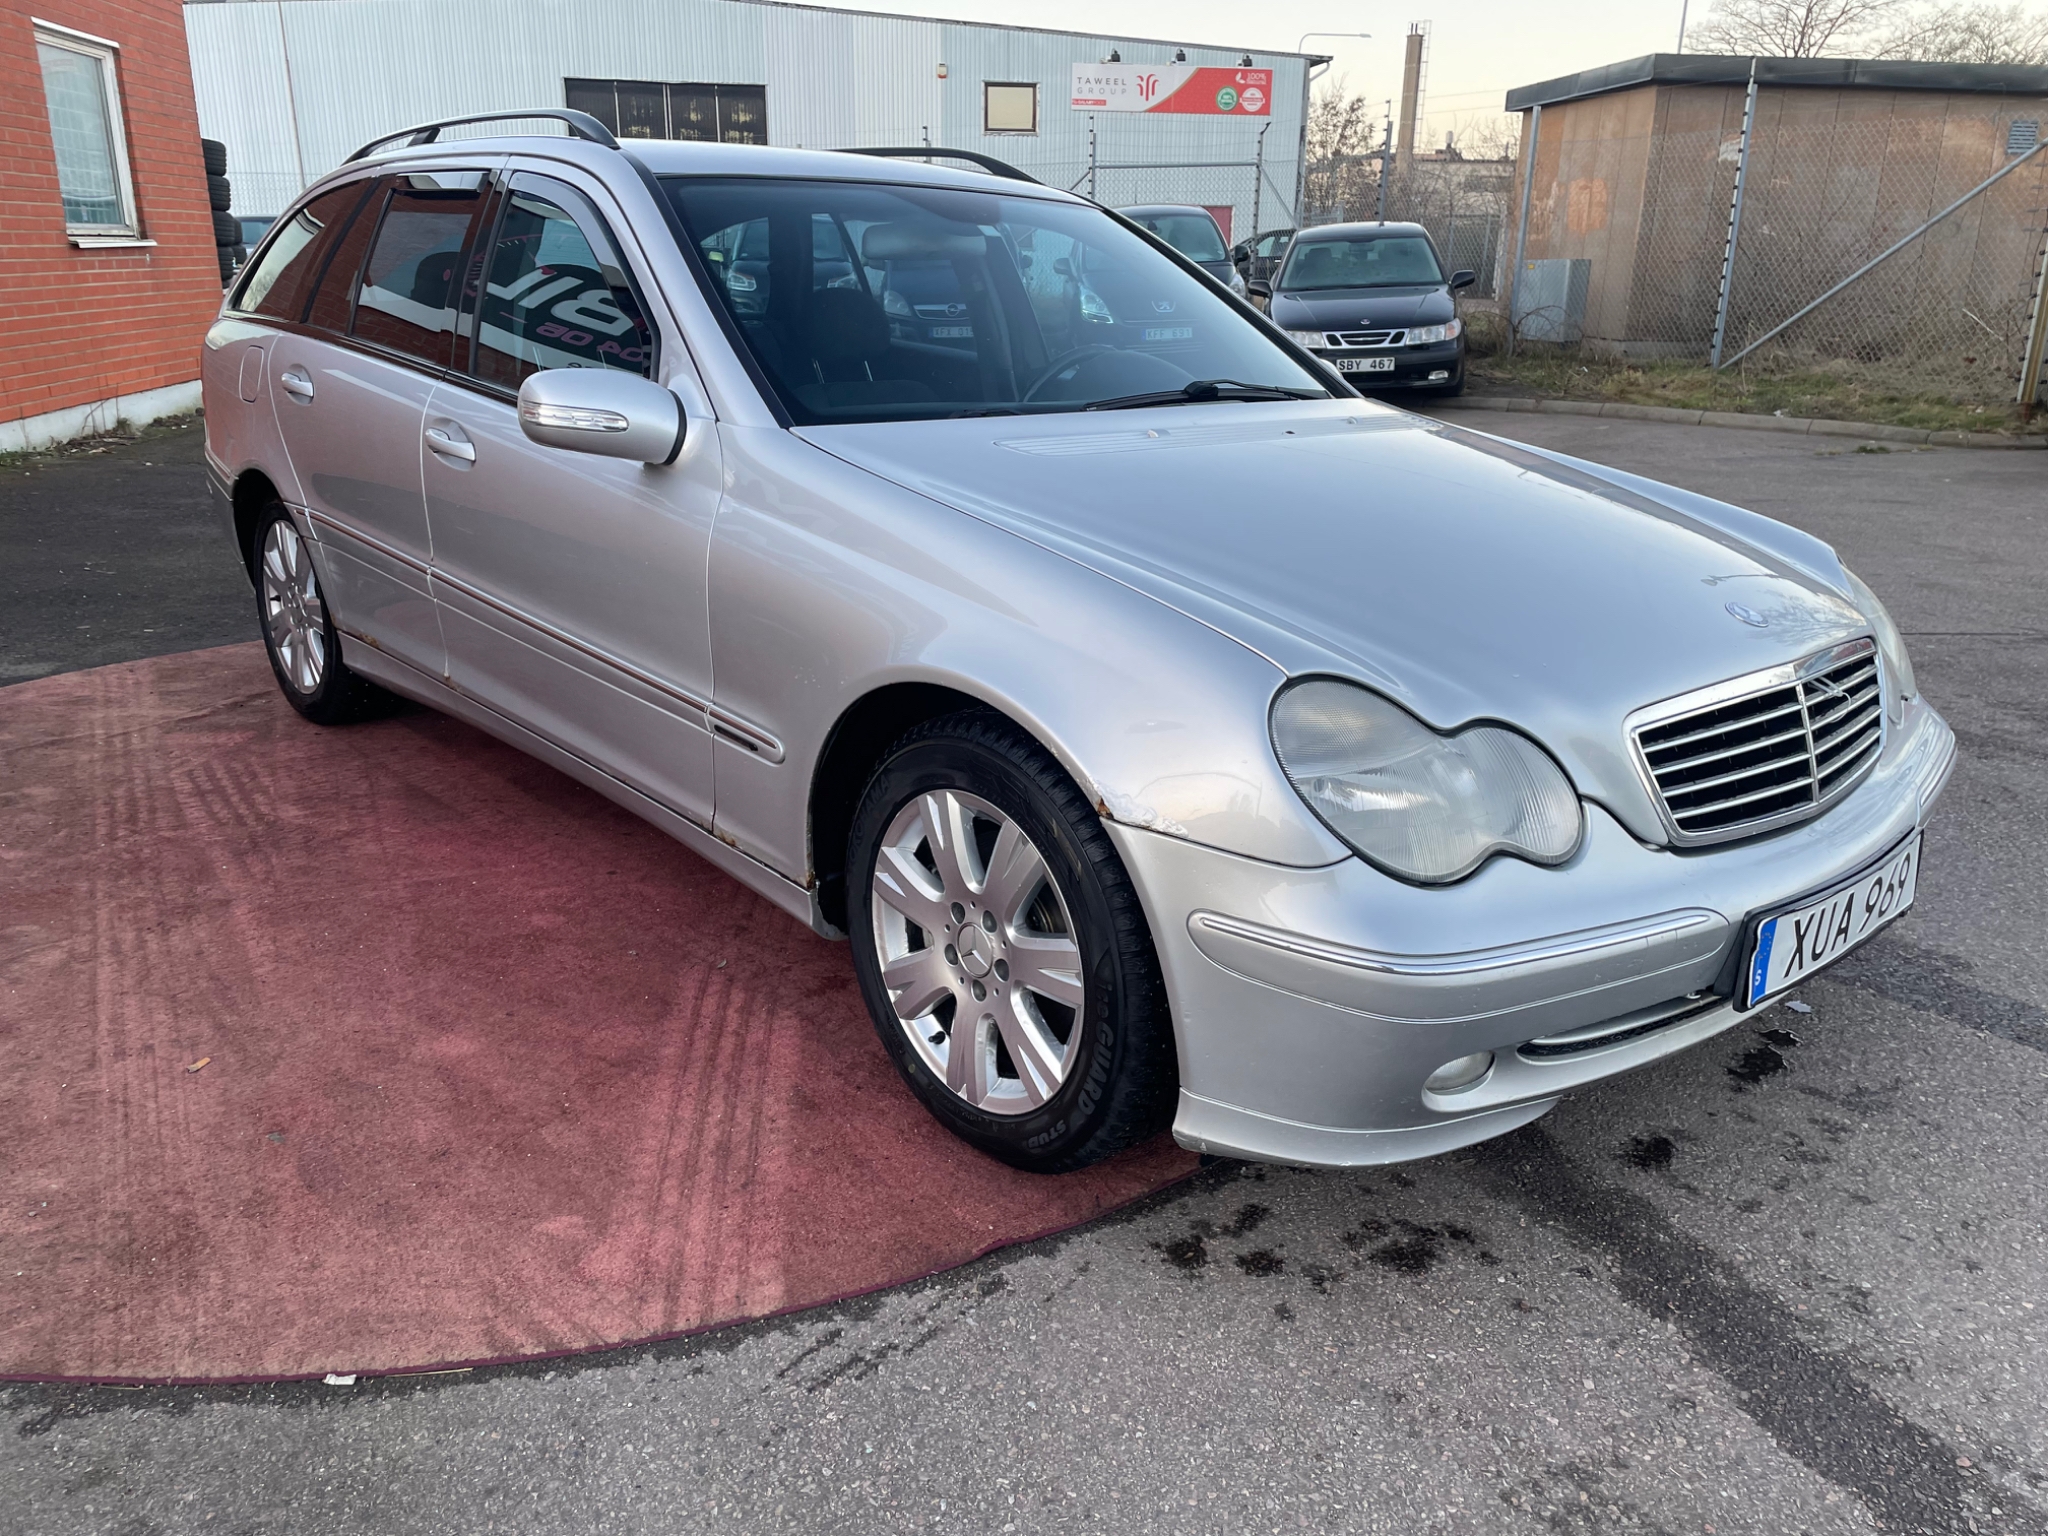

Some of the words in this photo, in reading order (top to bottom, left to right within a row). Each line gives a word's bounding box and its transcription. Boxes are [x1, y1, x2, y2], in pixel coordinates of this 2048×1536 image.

[1077, 77, 1127, 86] TAWEEL
[1077, 87, 1127, 95] GROUP
[1147, 330, 1165, 339] KFF
[1172, 329, 1191, 338] 691
[1338, 360, 1362, 371] SBY
[1370, 359, 1394, 370] 467
[1783, 891, 1856, 978] XUA
[1859, 852, 1911, 934] 969
[1754, 969, 1763, 986] S
[1027, 1119, 1067, 1148] STUD
